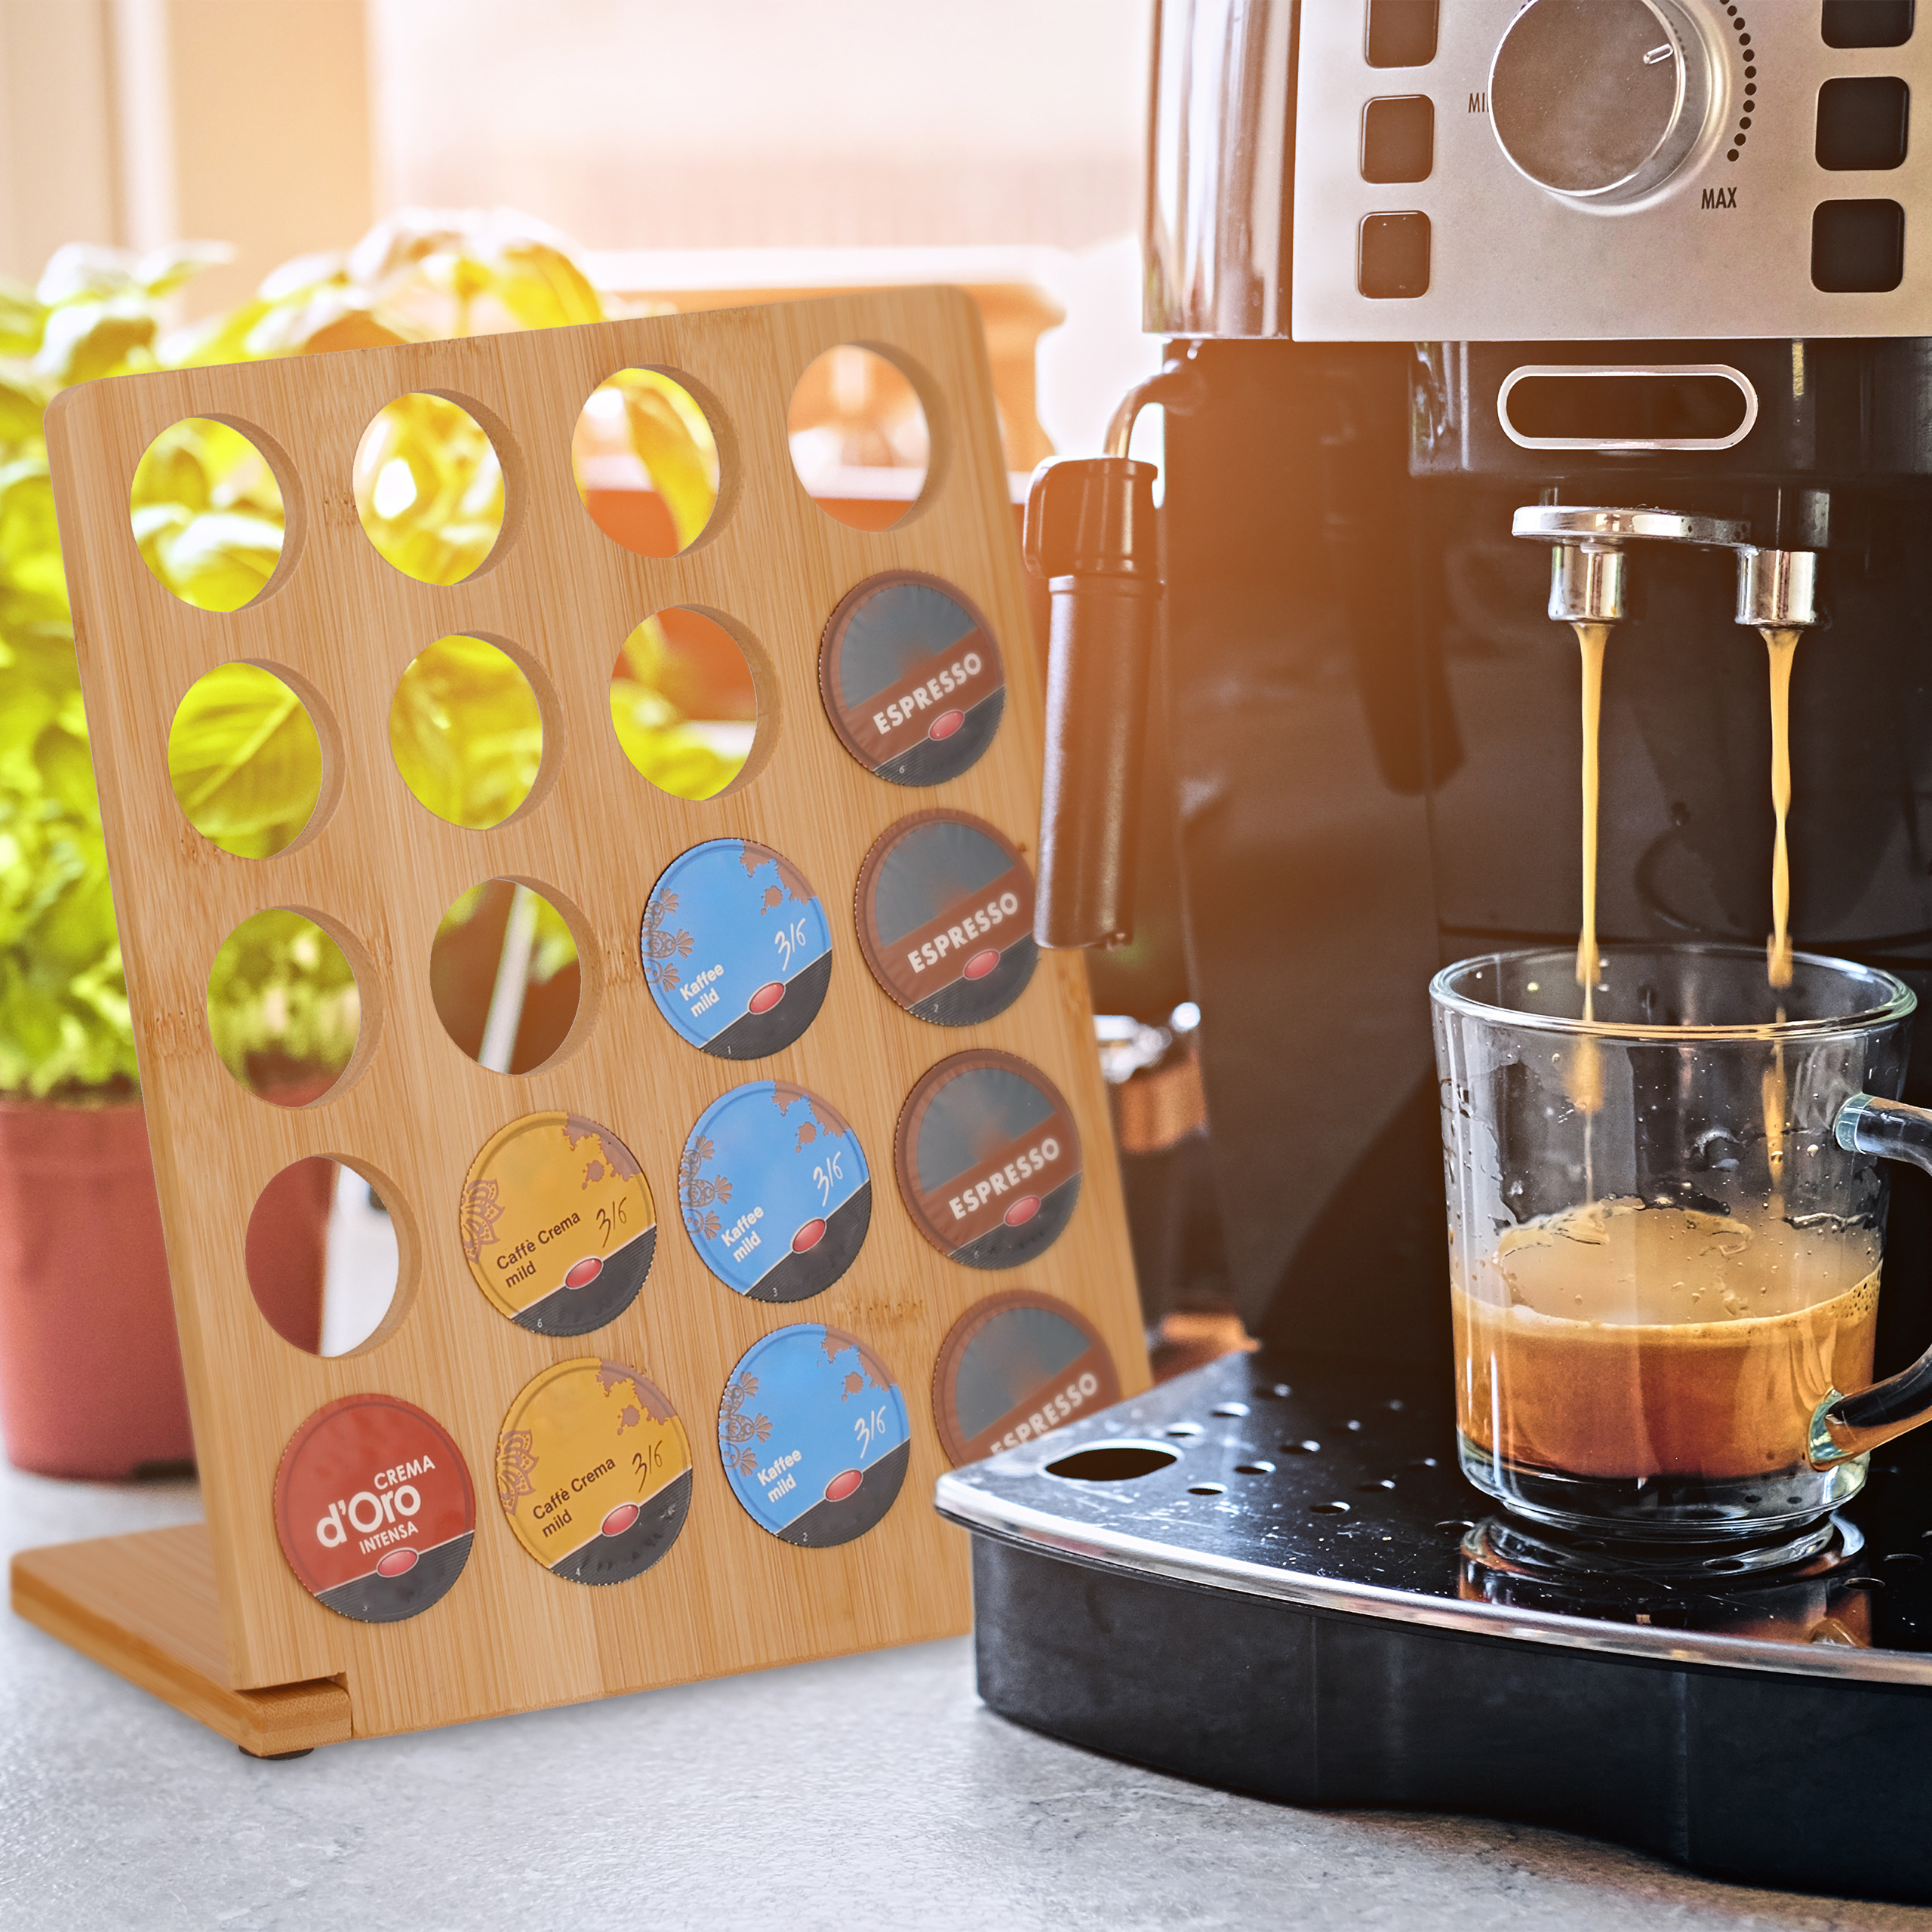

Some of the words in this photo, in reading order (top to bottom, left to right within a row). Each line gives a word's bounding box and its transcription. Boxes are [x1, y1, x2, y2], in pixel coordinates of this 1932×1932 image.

[1468, 92, 1489, 113] MI
[1701, 186, 1737, 209] MAX
[872, 653, 981, 735] ESPRESSO
[899, 765, 905, 774] 6
[774, 918, 806, 971] 3/6
[907, 893, 1018, 974] ESPRESSO
[679, 964, 724, 1001] Kaffee
[690, 988, 720, 1017] mild
[933, 1004, 939, 1013] 2
[813, 1151, 841, 1208] 3/6
[949, 1138, 1060, 1220] ESPRESSO
[595, 1197, 627, 1248] 3/6
[721, 1206, 764, 1247] Kaffee
[497, 1239, 537, 1269] Caffè
[537, 1212, 581, 1244] Crema
[733, 1230, 761, 1263] mild
[974, 1251, 980, 1260] 6
[505, 1261, 537, 1288] mild
[772, 1287, 778, 1297] 3
[537, 1318, 543, 1328] 6
[854, 1405, 886, 1460] 3/6
[374, 1455, 435, 1490] CREMA
[632, 1440, 663, 1494] 3/6
[756, 1450, 802, 1486] Kaffee
[533, 1488, 571, 1520] Caffè
[571, 1458, 616, 1493] Crema
[767, 1473, 797, 1503] mild
[316, 1484, 421, 1549] d'Oro
[542, 1509, 572, 1537] mild
[359, 1521, 419, 1555] INTENSA
[802, 1532, 808, 1542] 2
